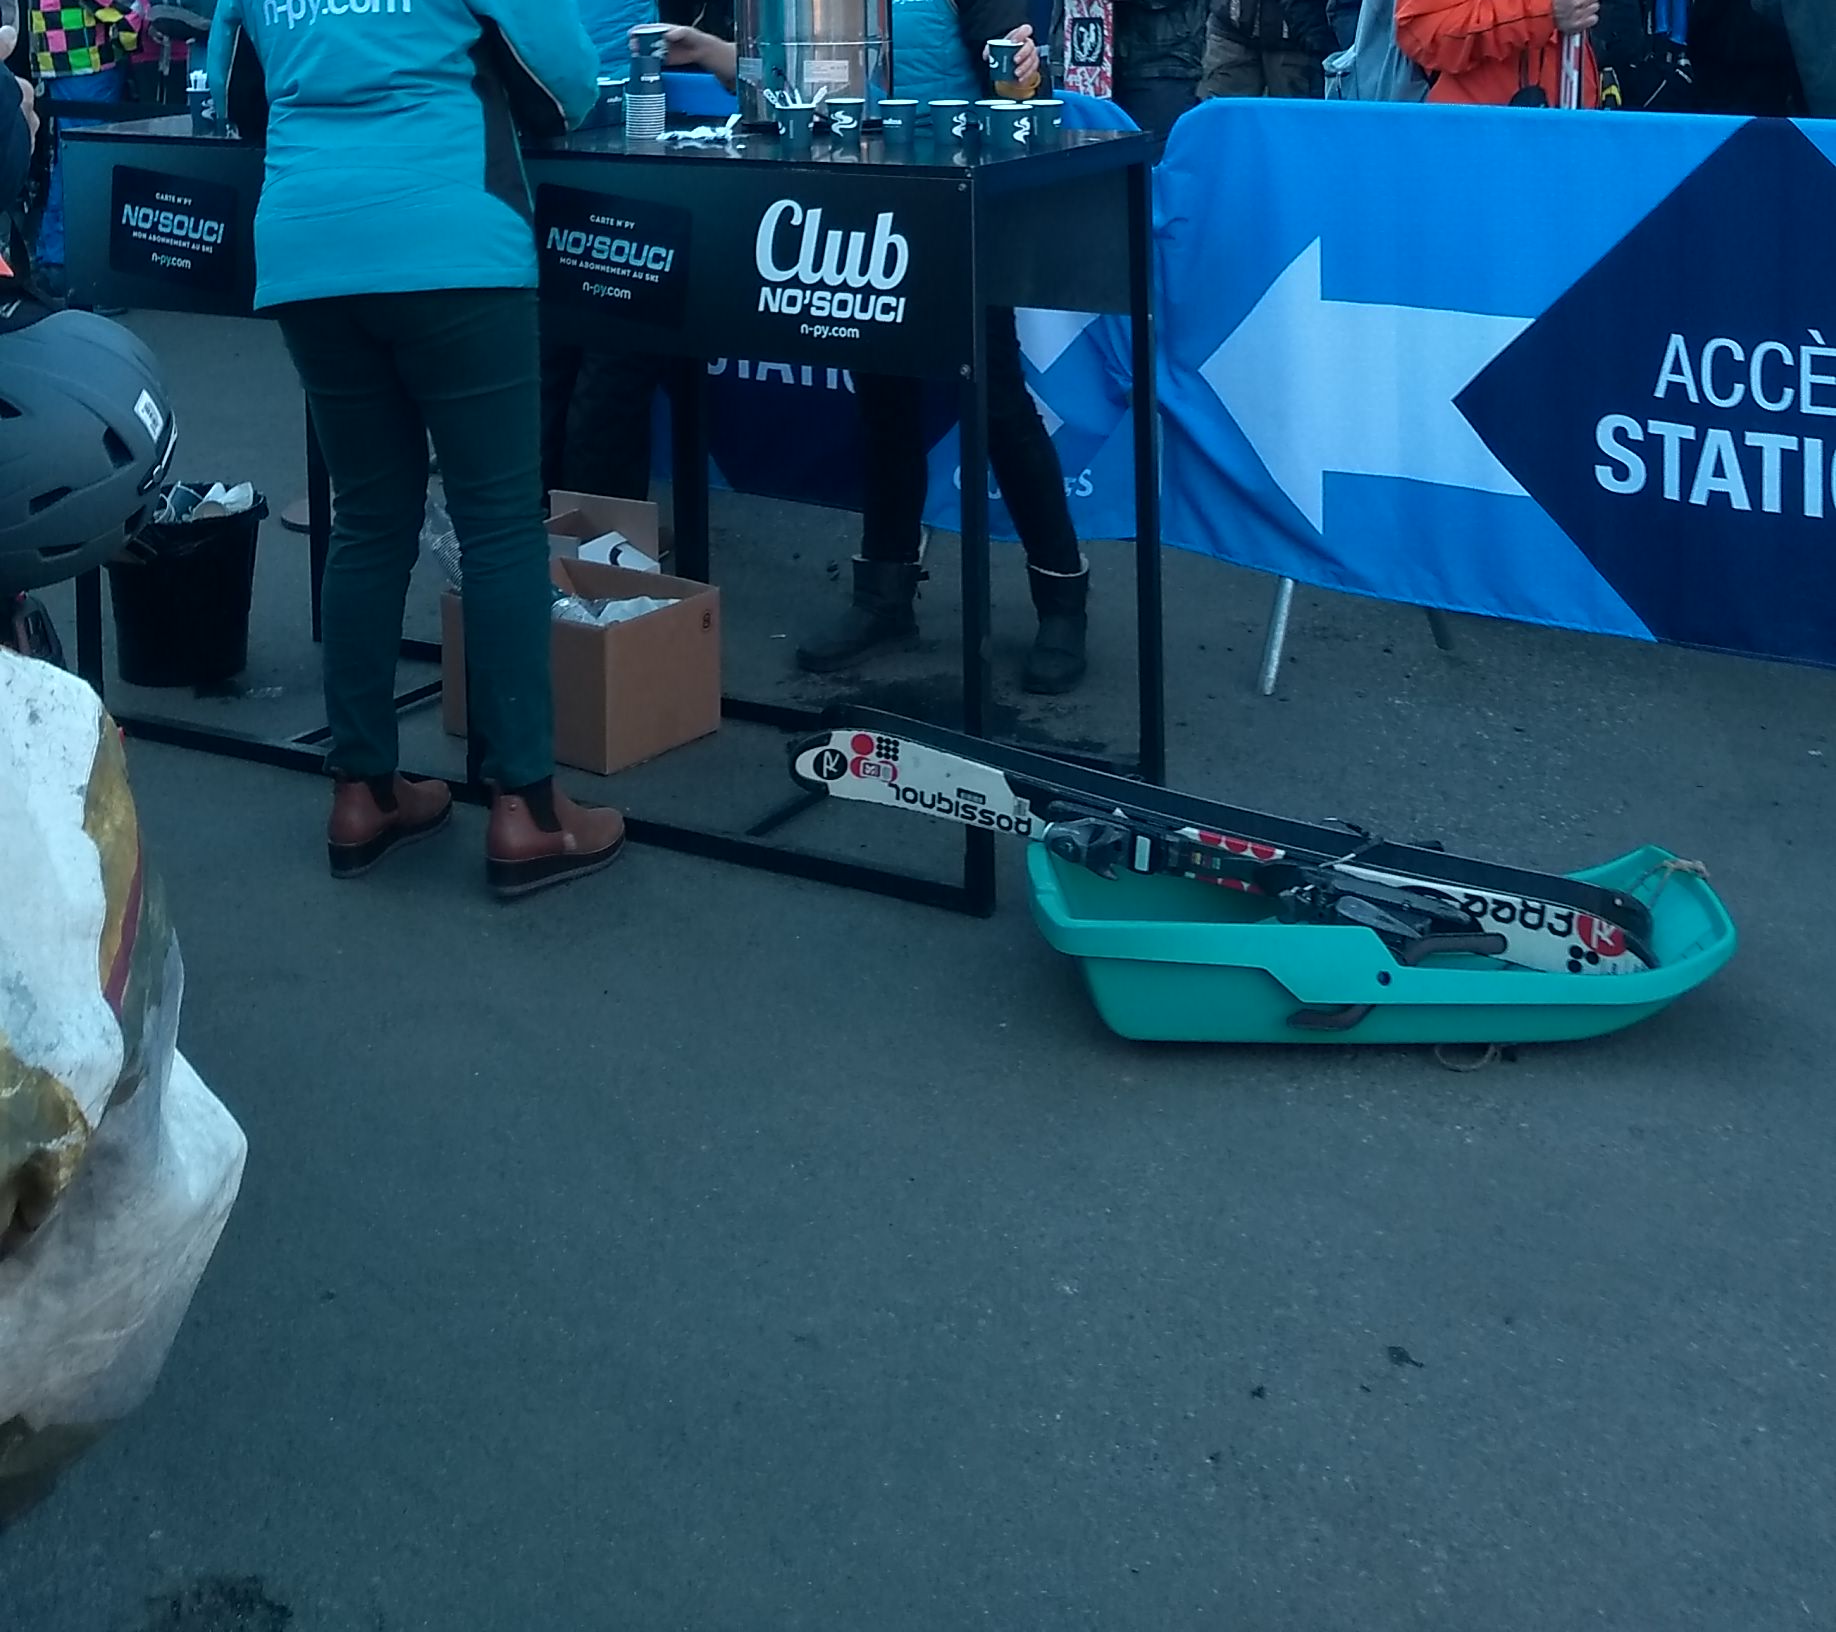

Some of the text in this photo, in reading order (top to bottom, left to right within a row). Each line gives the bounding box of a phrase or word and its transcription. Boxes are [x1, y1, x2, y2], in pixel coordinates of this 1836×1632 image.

[155, 192, 176, 204] CARTE
[122, 204, 225, 244] NO'SOUCI
[589, 214, 615, 226] CARTE
[133, 231, 213, 254] MON ABONNEMENT AU SKI
[546, 227, 675, 272] NO'SOUCI
[756, 199, 909, 290] Club
[151, 252, 192, 269] n-py.com
[560, 257, 659, 283] MON ABONNEMENT AU SKI
[582, 282, 631, 300] n-py.com
[757, 286, 906, 323] NO'SOUCI
[800, 323, 860, 338] n-py.com
[1653, 328, 1836, 416] ACCÈ
[1594, 414, 1836, 518] STATI
